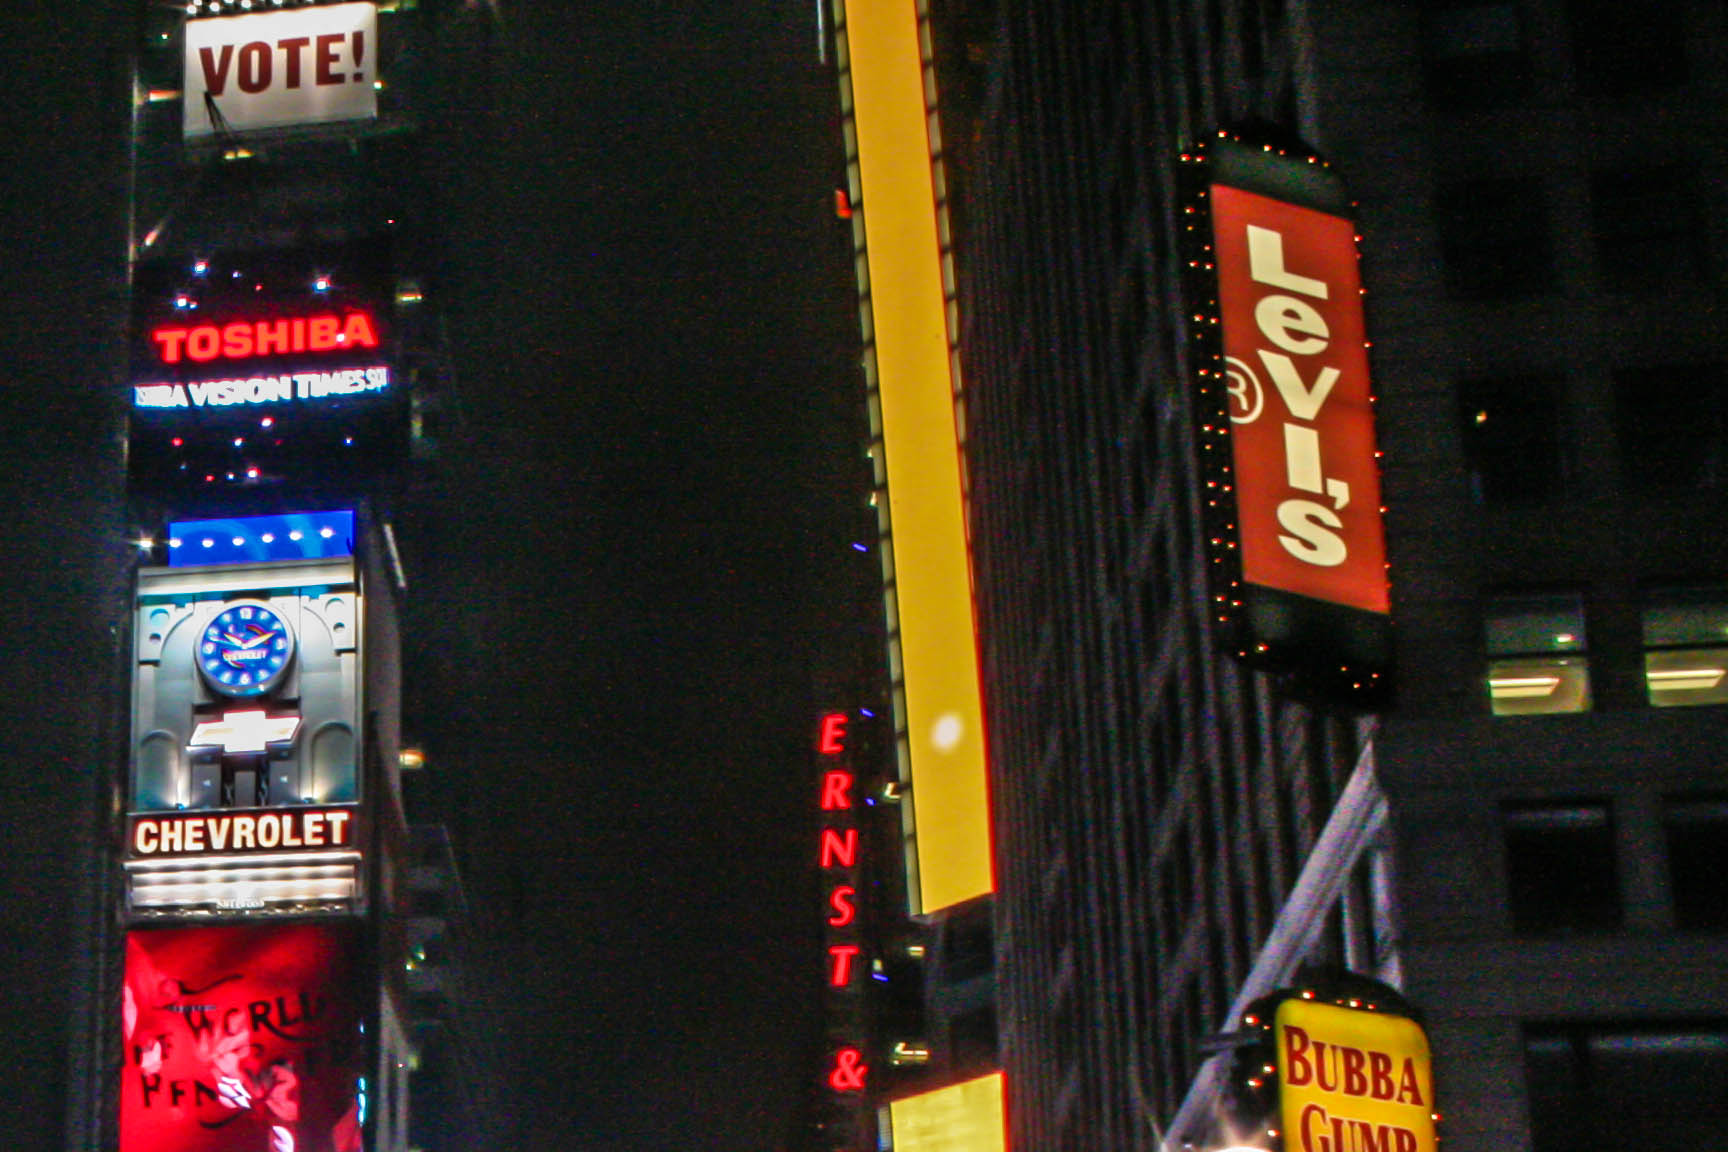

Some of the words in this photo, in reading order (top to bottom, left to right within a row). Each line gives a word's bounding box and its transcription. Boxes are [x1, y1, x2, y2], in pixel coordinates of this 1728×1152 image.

[200, 31, 364, 97] VOTE!
[154, 314, 377, 363] TOSHIBA
[136, 812, 350, 854] CHEVROLET
[818, 712, 859, 990] ERNST
[828, 1046, 868, 1091] &
[1283, 1024, 1425, 1108] BUBBA
